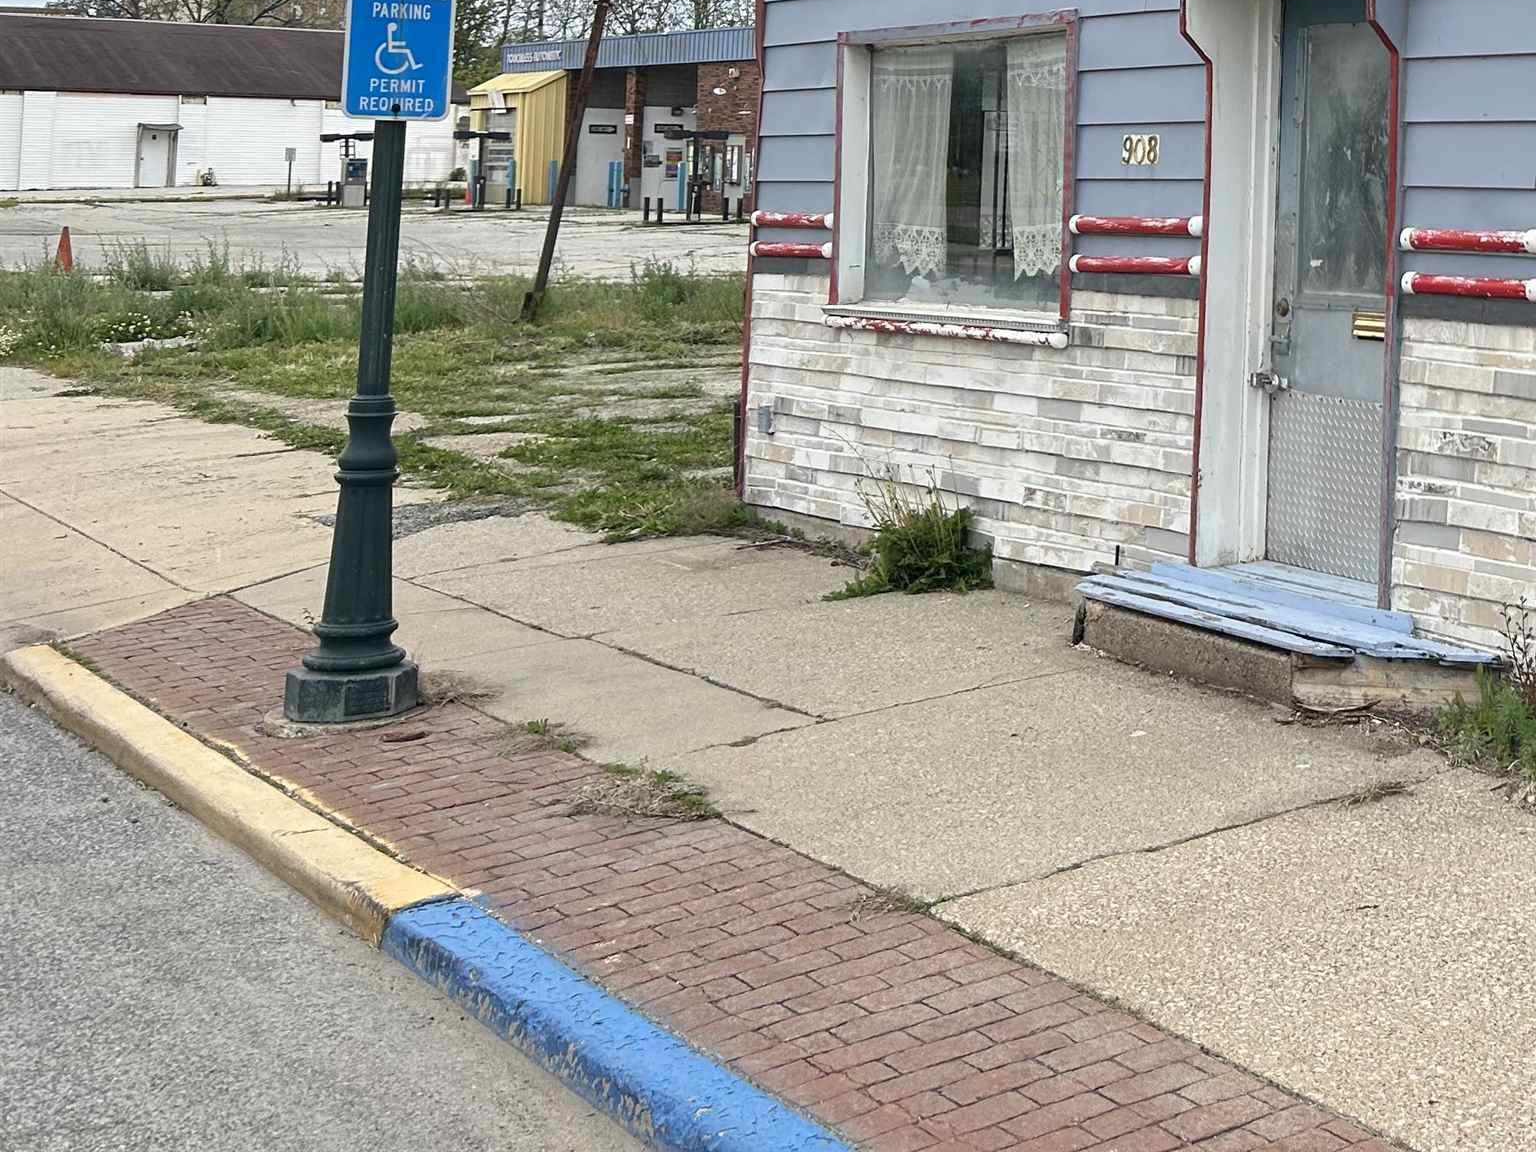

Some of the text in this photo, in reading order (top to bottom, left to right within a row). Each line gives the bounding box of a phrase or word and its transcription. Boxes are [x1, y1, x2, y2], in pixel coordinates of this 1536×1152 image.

[372, 1, 432, 20] PARKING
[369, 78, 426, 93] PERMIT
[1121, 135, 1159, 165] 908
